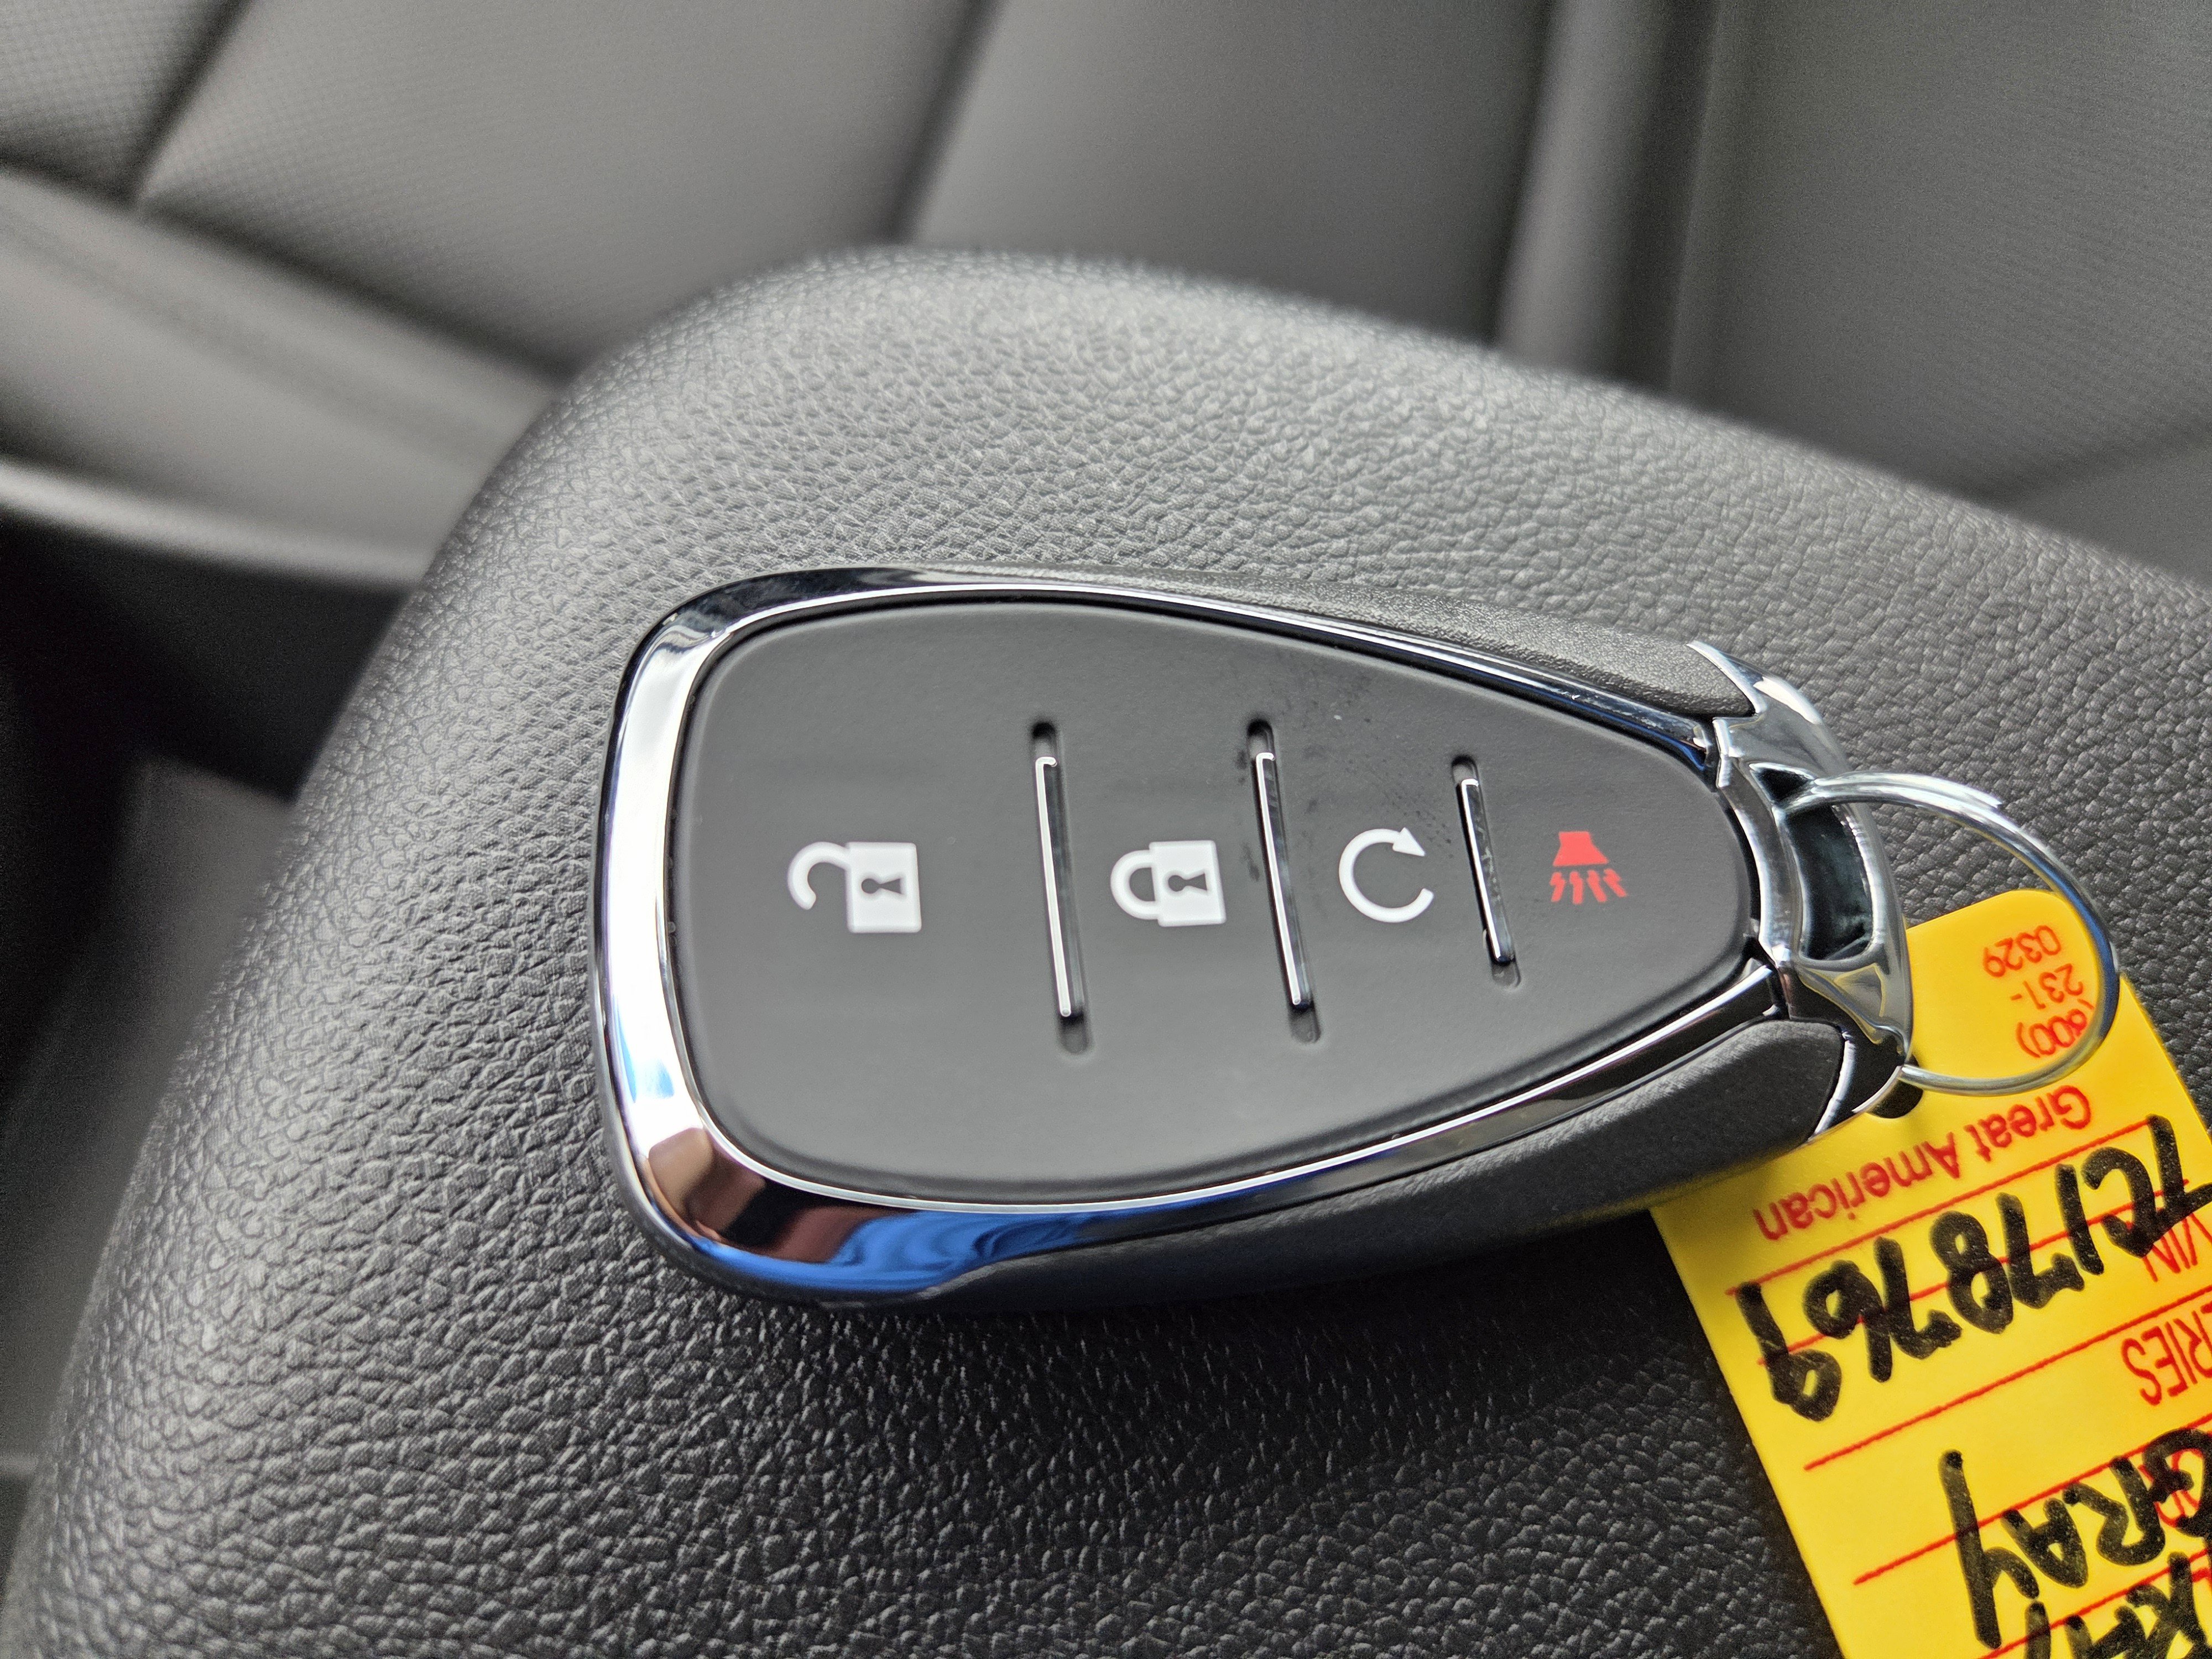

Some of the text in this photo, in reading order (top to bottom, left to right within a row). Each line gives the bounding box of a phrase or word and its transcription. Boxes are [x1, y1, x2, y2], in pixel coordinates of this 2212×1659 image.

[1983, 925, 2062, 978] 0329
[2010, 963, 2084, 1010] 231-
[1752, 1085, 2091, 1240] Great American
[2122, 1300, 2212, 1406] RIES
[1939, 1429, 2212, 1649] GRAY
